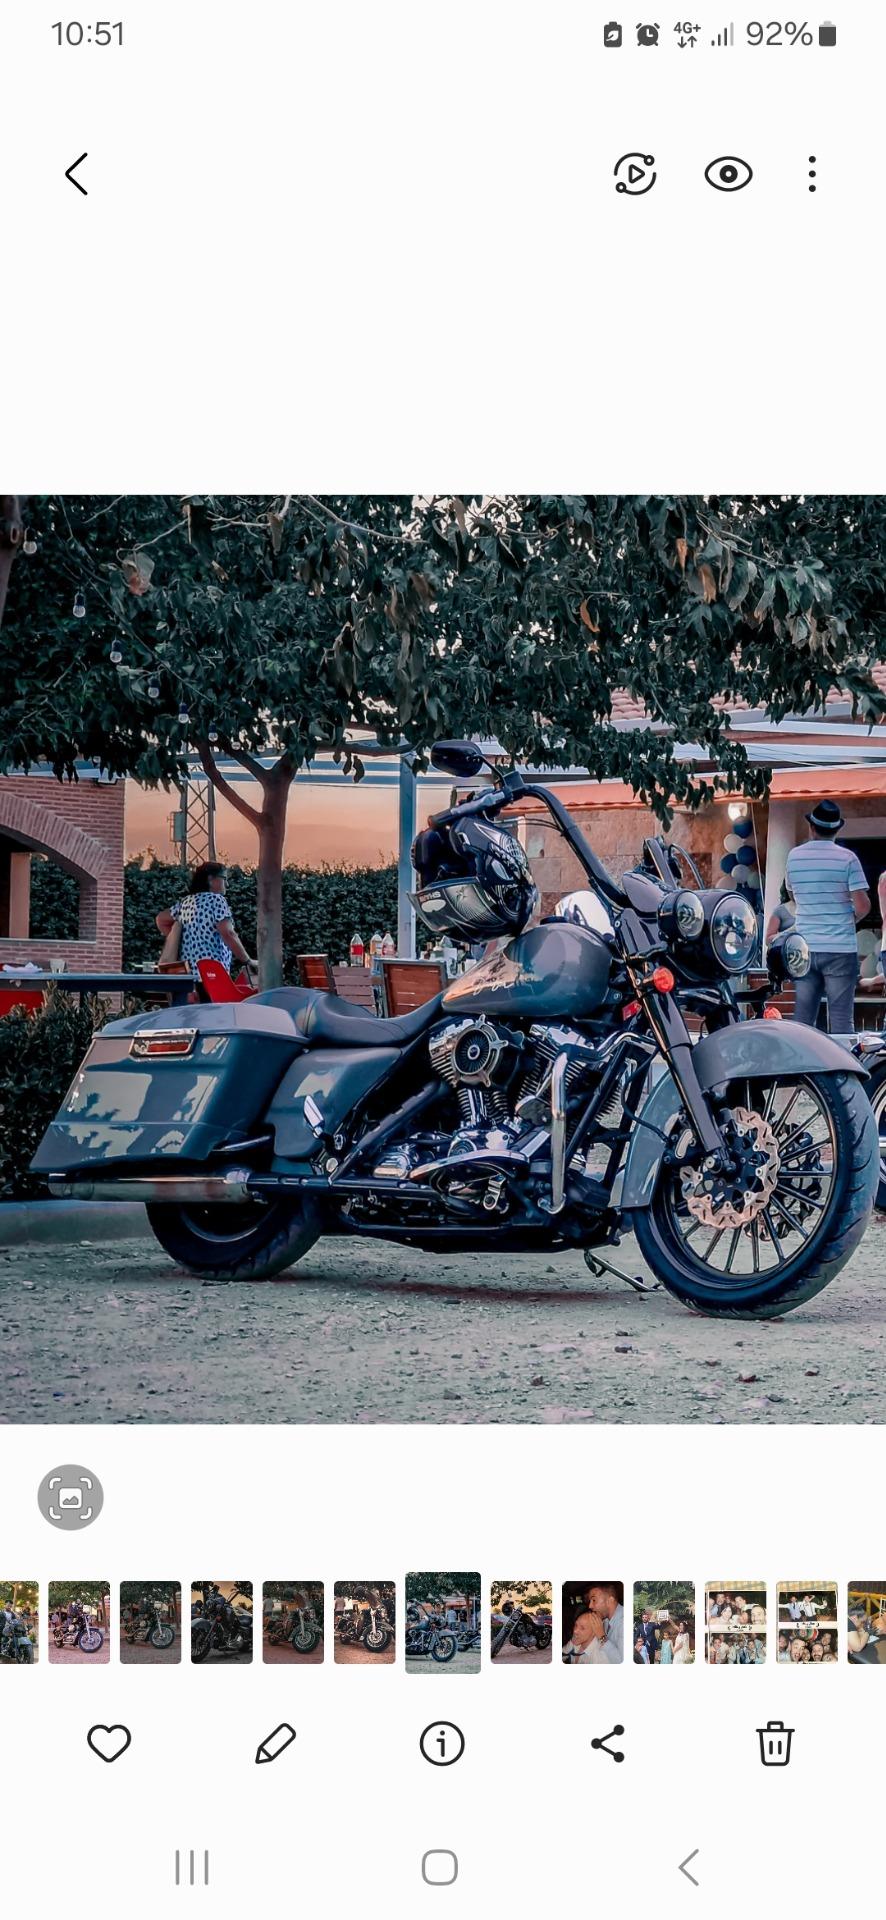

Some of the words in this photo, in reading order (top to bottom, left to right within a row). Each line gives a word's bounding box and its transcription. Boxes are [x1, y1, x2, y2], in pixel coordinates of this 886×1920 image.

[51, 21, 123, 46] 10:51
[673, 21, 702, 34] 4G+
[746, 21, 814, 46] 92%
